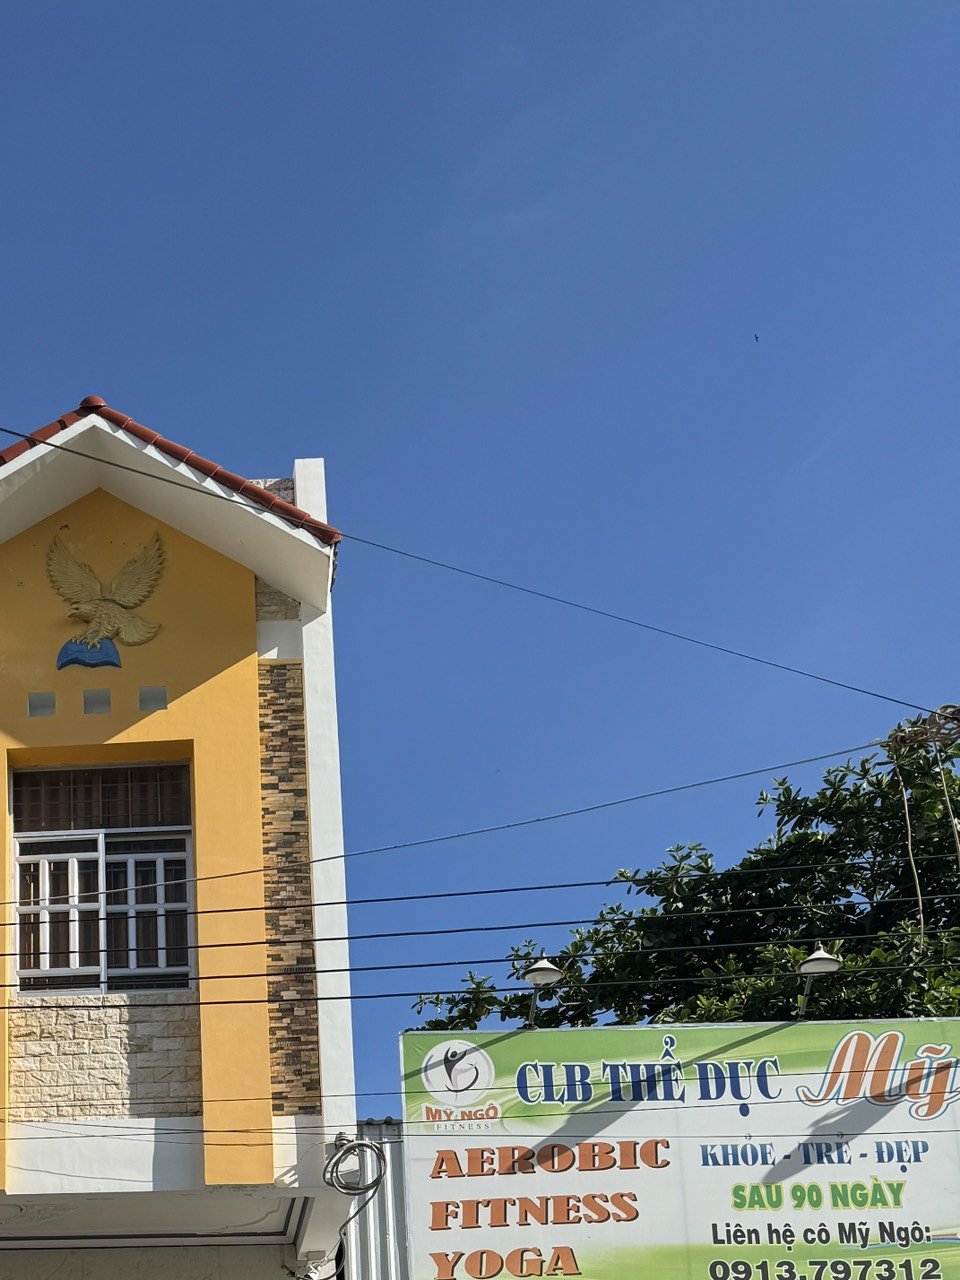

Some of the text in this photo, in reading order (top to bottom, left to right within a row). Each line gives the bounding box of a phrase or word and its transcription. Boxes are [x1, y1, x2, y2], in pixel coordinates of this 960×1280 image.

[516, 1034, 782, 1117] CLB THỂ DỤC
[796, 1030, 960, 1121] Mỹ
[437, 1123, 490, 1131] FITNESS
[461, 1103, 498, 1119] NGÔ
[430, 1139, 670, 1178] AEROBIC
[699, 1133, 776, 1166] KHỎE
[798, 1131, 851, 1166] TRẺ
[874, 1140, 930, 1173] ĐẸP
[428, 1192, 640, 1231] FITNESS
[731, 1175, 907, 1211] SAU 90 NGÀY
[711, 1221, 932, 1251] Liên hệ cô Mỹ Ngô:
[429, 1246, 582, 1280] YOGA
